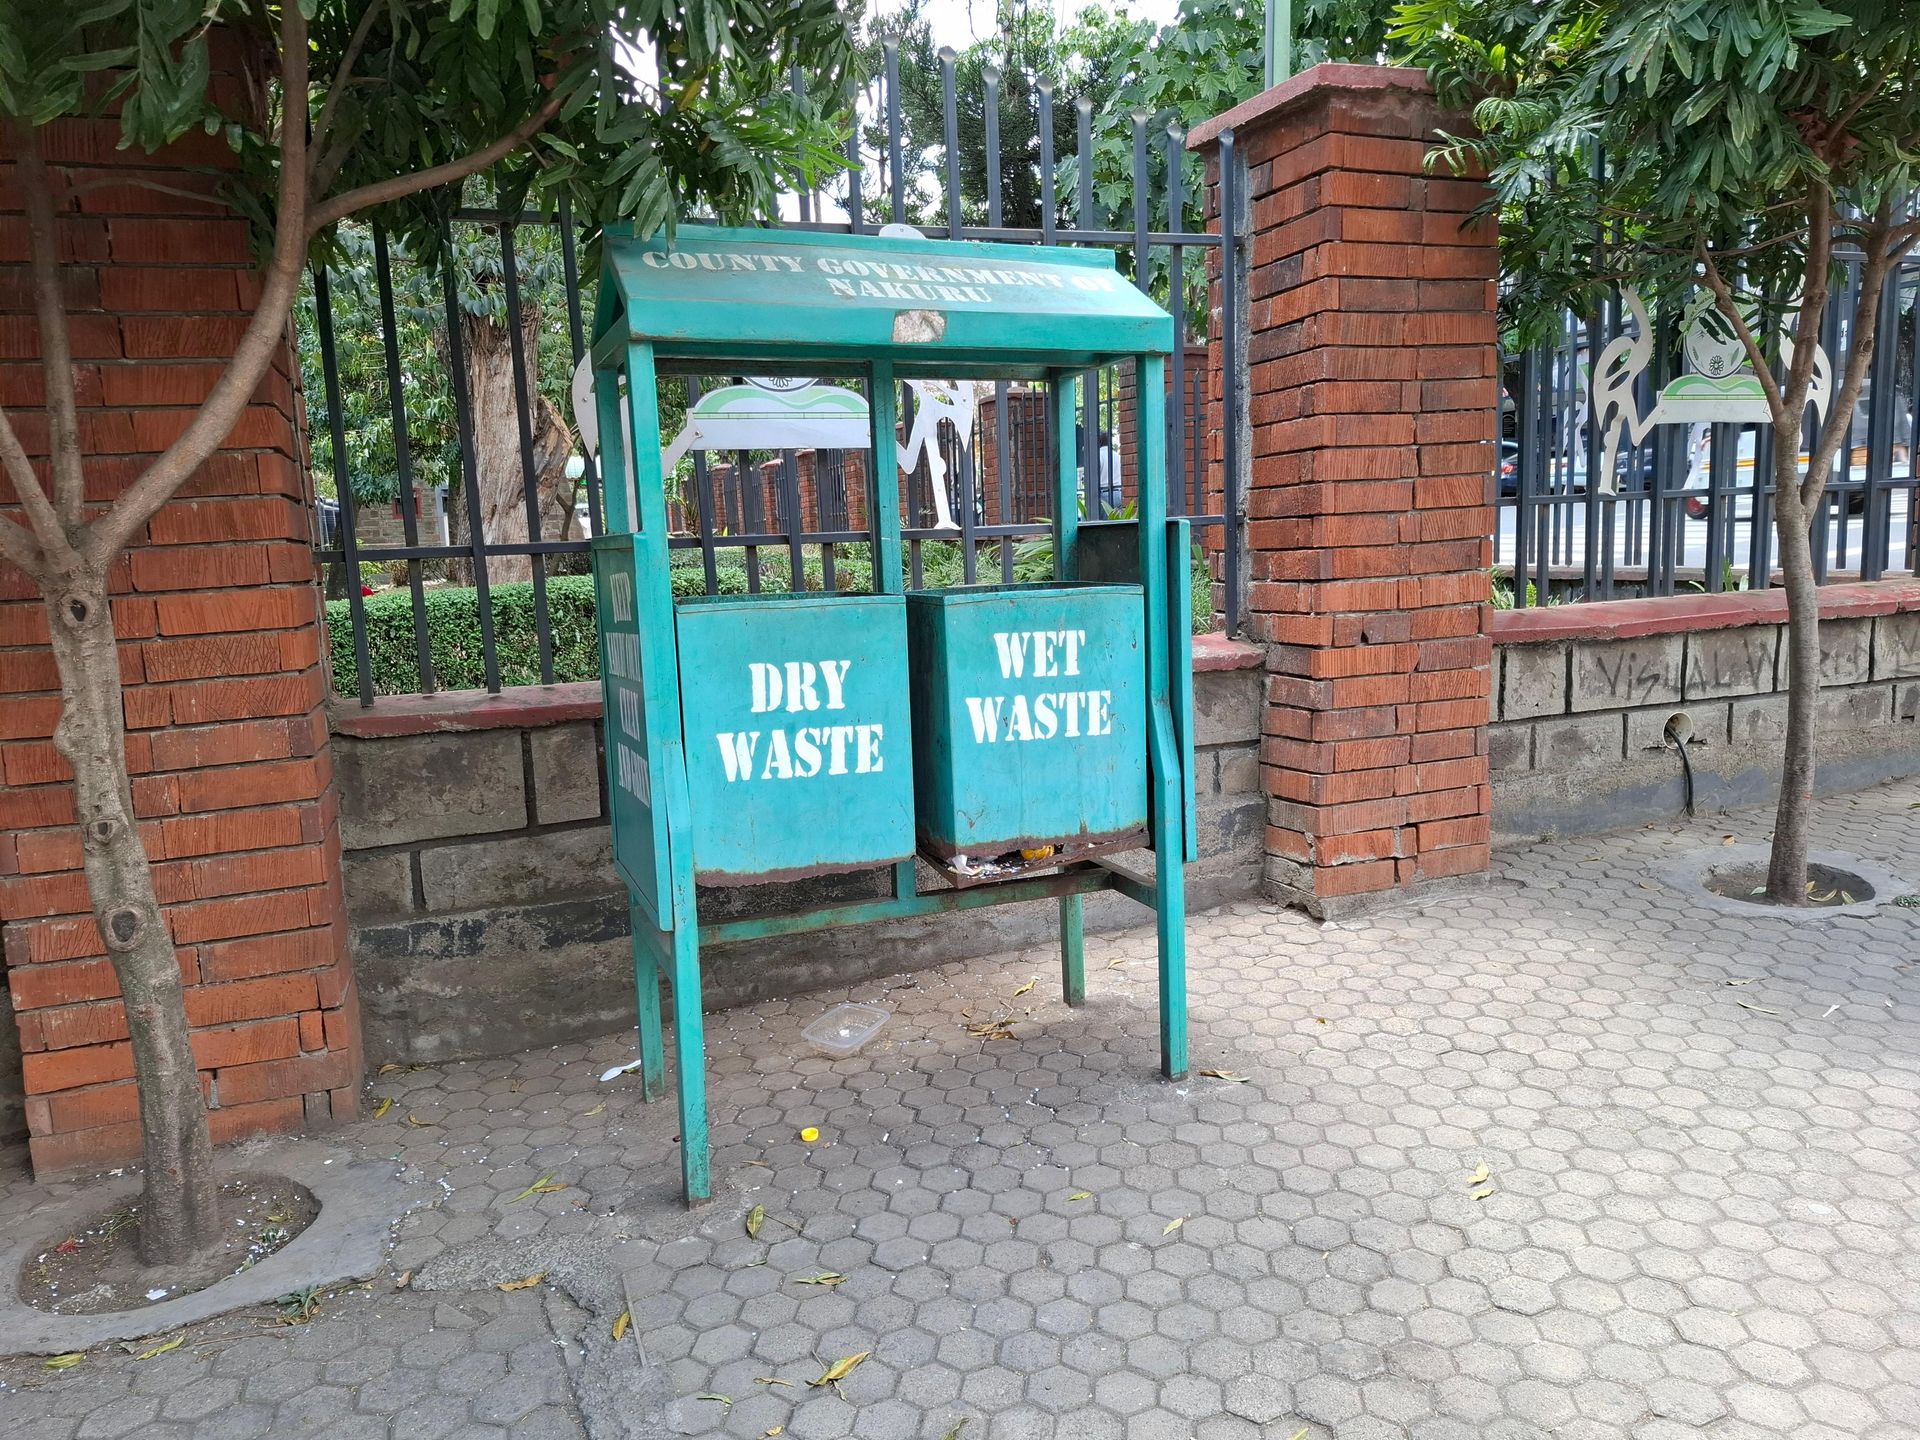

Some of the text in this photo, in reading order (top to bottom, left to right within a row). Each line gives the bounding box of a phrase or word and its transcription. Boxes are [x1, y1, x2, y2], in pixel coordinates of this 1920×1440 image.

[642, 250, 806, 273] COUNTY
[816, 257, 1063, 290] GOVERNMENT
[828, 279, 991, 303] NAKURU
[993, 629, 1087, 679] WET
[748, 660, 852, 713] DRY
[965, 690, 1113, 744] WASTE
[716, 724, 885, 782] WASTE
